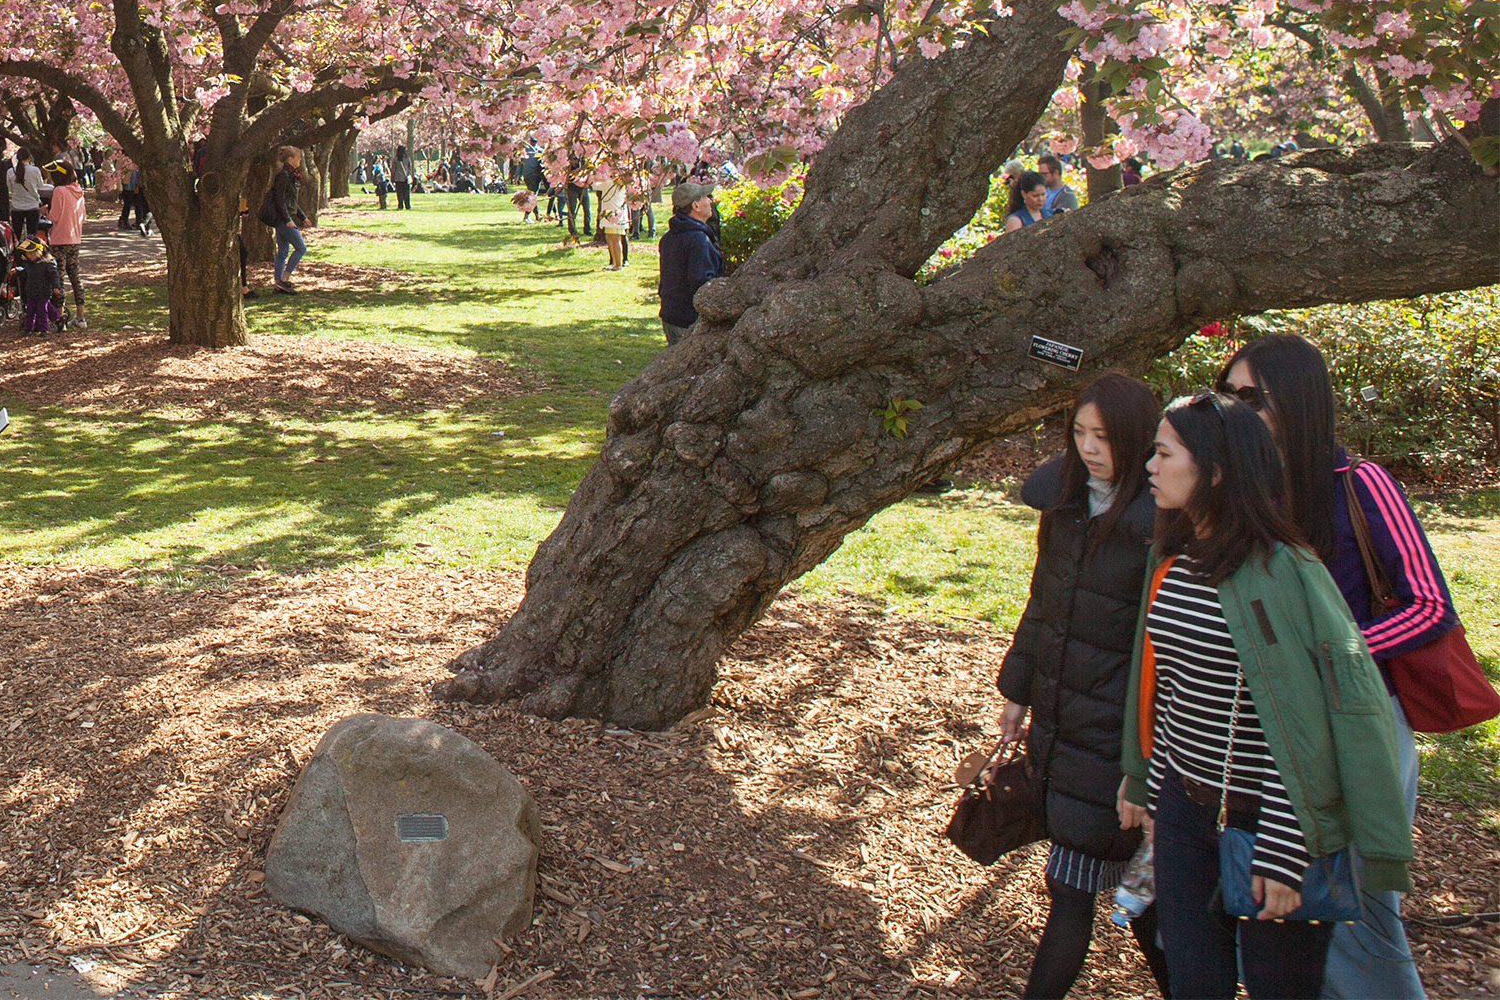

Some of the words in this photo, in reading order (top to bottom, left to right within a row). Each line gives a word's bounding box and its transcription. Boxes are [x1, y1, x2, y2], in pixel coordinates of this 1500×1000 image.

[1033, 342, 1059, 354] FLOWERING
[1059, 350, 1079, 360] CHERRY
[1046, 342, 1069, 352] JAPANESE
